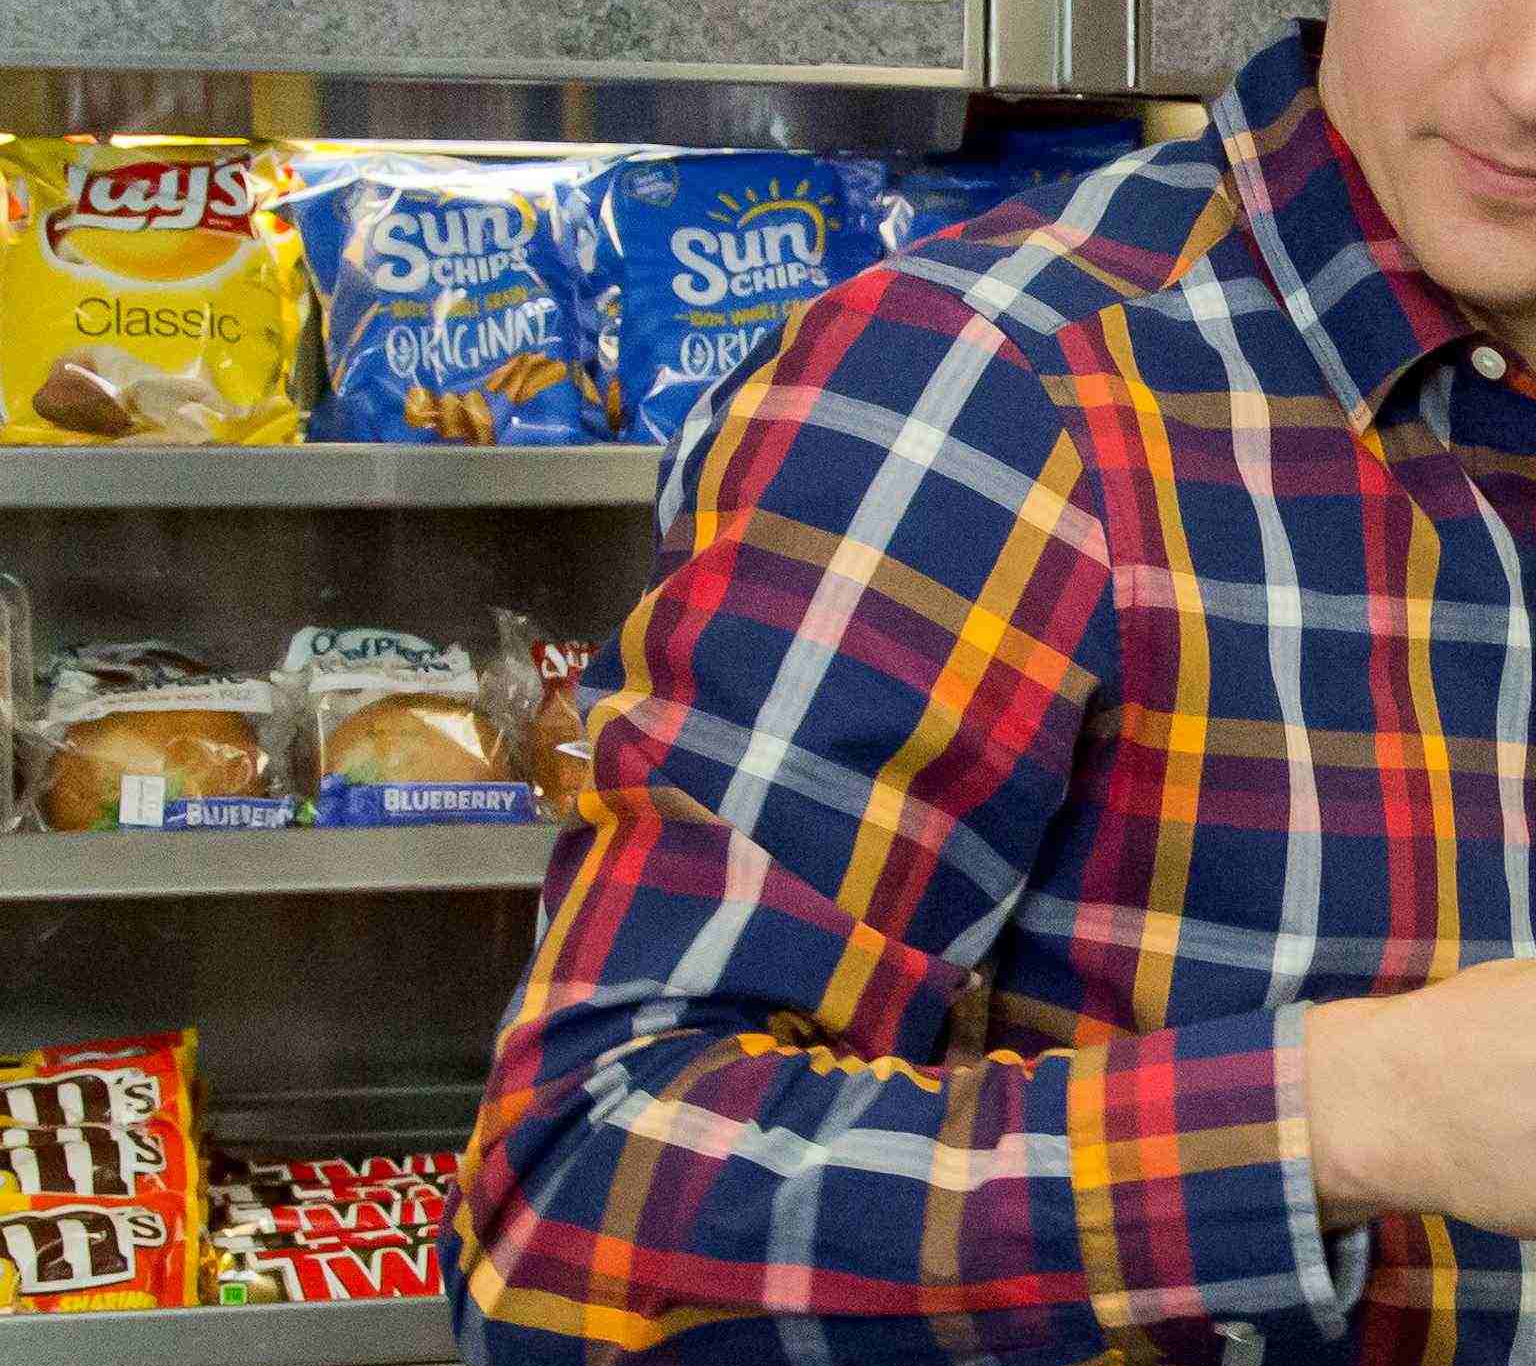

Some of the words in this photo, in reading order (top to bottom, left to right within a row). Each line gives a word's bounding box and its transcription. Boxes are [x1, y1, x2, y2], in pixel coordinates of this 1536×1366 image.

[373, 204, 528, 293] Sun
[670, 221, 821, 307] Sun
[73, 295, 242, 344] Classic
[383, 788, 517, 813] BLUEBERRY
